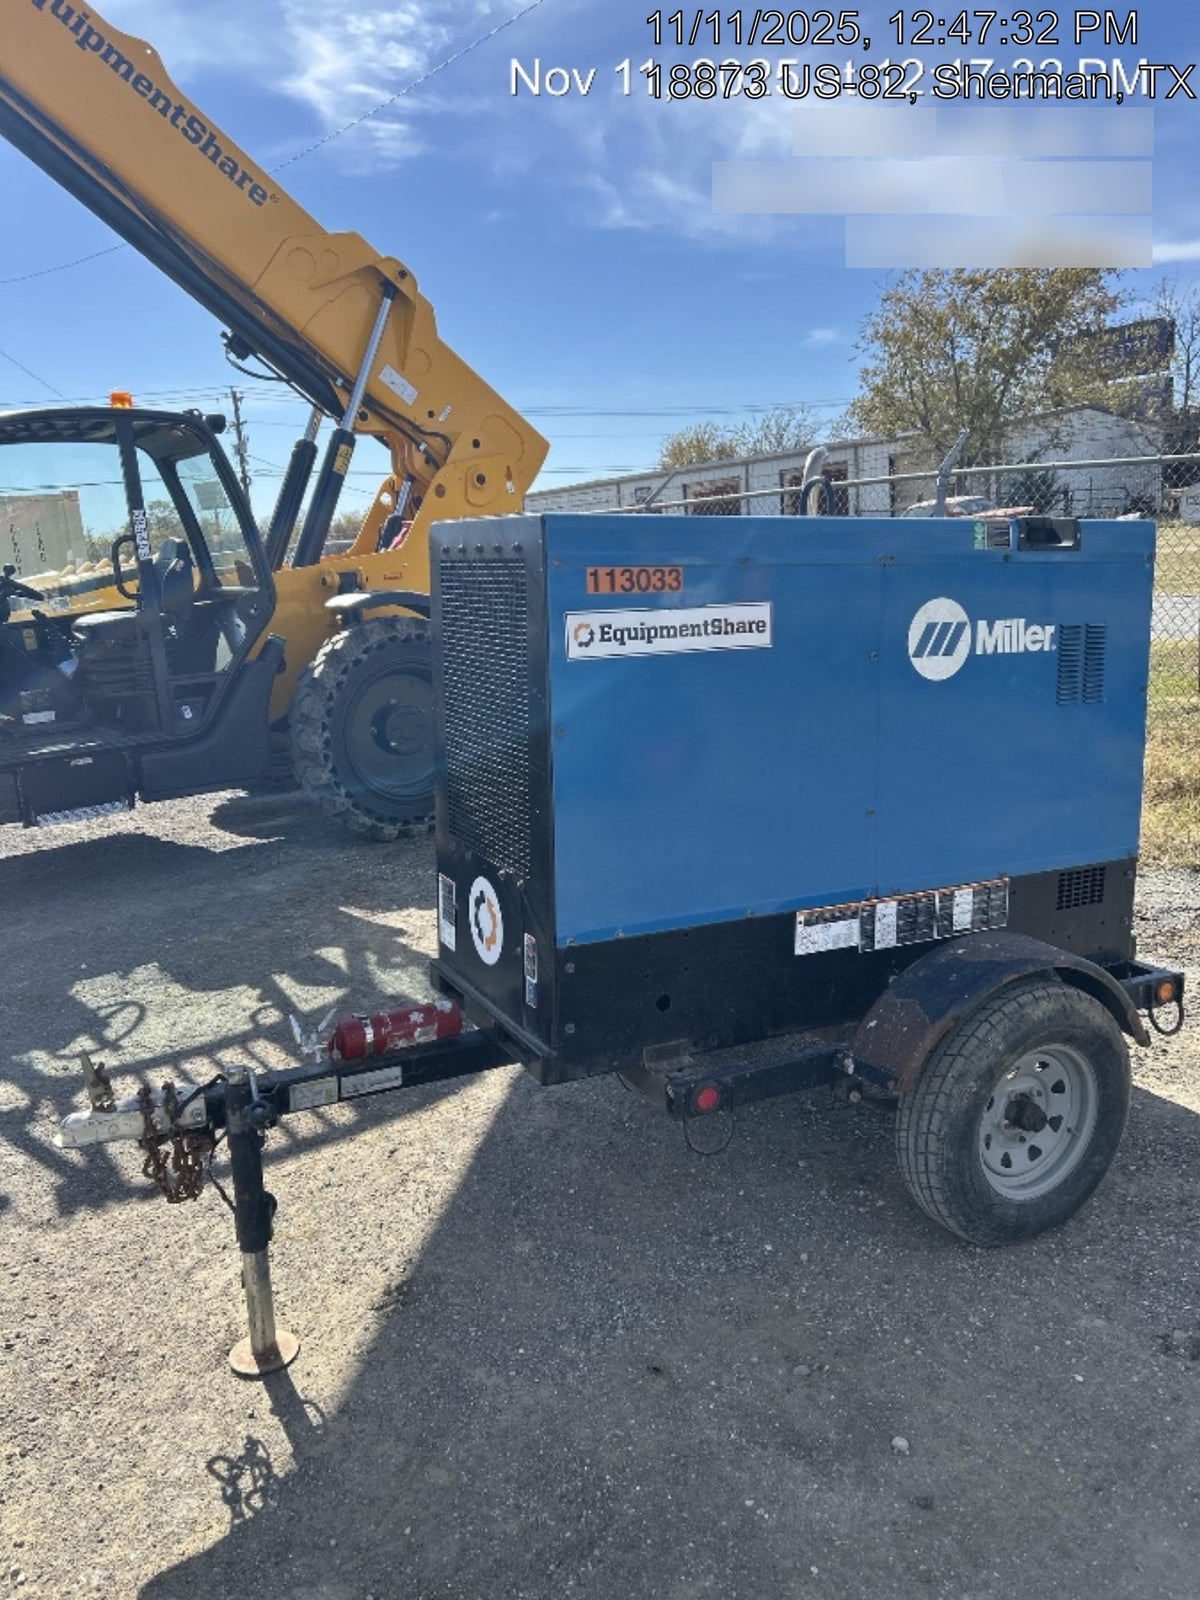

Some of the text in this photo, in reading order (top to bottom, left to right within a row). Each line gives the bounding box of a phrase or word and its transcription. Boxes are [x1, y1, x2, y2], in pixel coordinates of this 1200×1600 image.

[589, 568, 682, 593] 113033
[598, 618, 767, 645] EquipmentShare
[976, 618, 1056, 655] Miller
